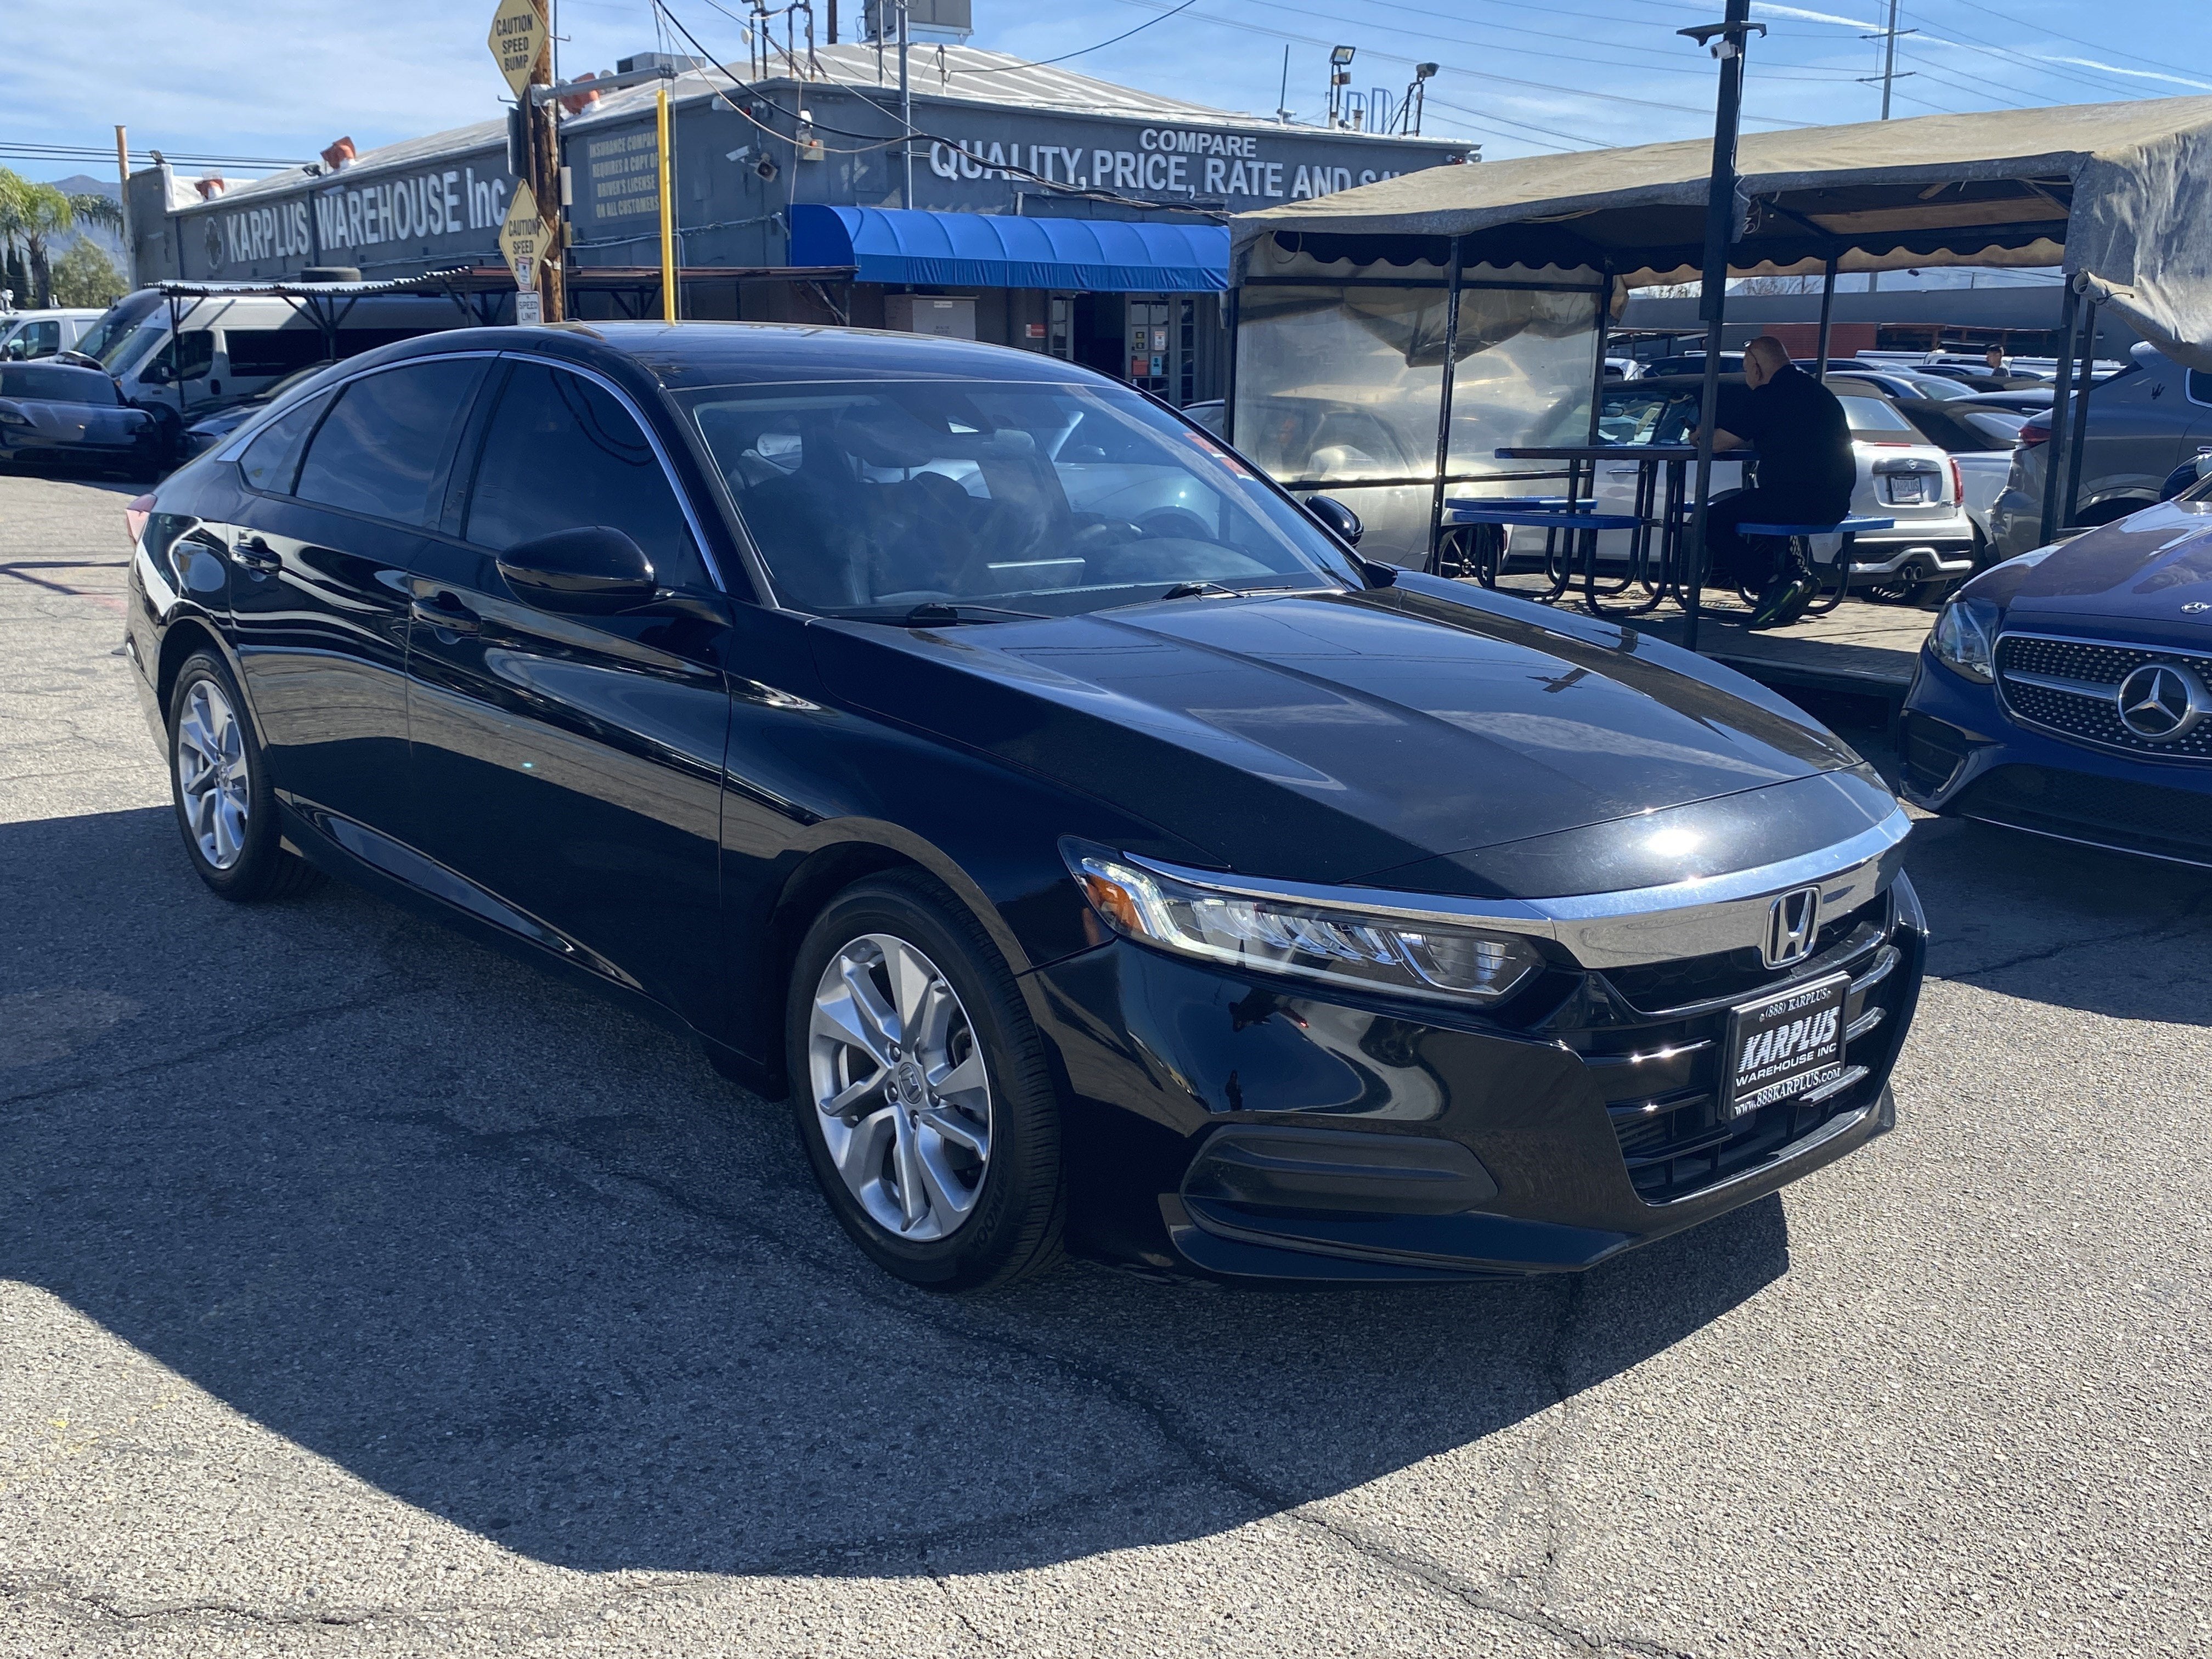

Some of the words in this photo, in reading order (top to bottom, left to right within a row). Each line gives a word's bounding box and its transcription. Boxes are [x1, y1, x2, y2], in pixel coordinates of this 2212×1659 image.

[496, 14, 533, 36] CAUTION
[503, 36, 529, 54] SPEED
[504, 54, 528, 72] BUMP
[1140, 128, 1257, 158] COMPARE
[627, 174, 656, 193] LICENSE
[1092, 149, 1195, 199] PRICE,
[1204, 157, 1283, 197] RATE
[1291, 164, 1352, 199] AND
[226, 201, 310, 263] KARPLUS
[315, 170, 464, 250] WAREHOUSE
[466, 167, 509, 229] Inc
[509, 218, 539, 237] CAUTION
[513, 240, 534, 255] SPEED
[519, 301, 538, 309] SPEED
[521, 312, 537, 321] LIMIT
[1765, 1002, 1786, 1018] (888)
[1788, 988, 1827, 1011] KARPLUS
[1737, 1006, 1841, 1073] KARPLUS
[1735, 1051, 1814, 1087] WAREHOUSE
[1817, 1043, 1837, 1057] INC
